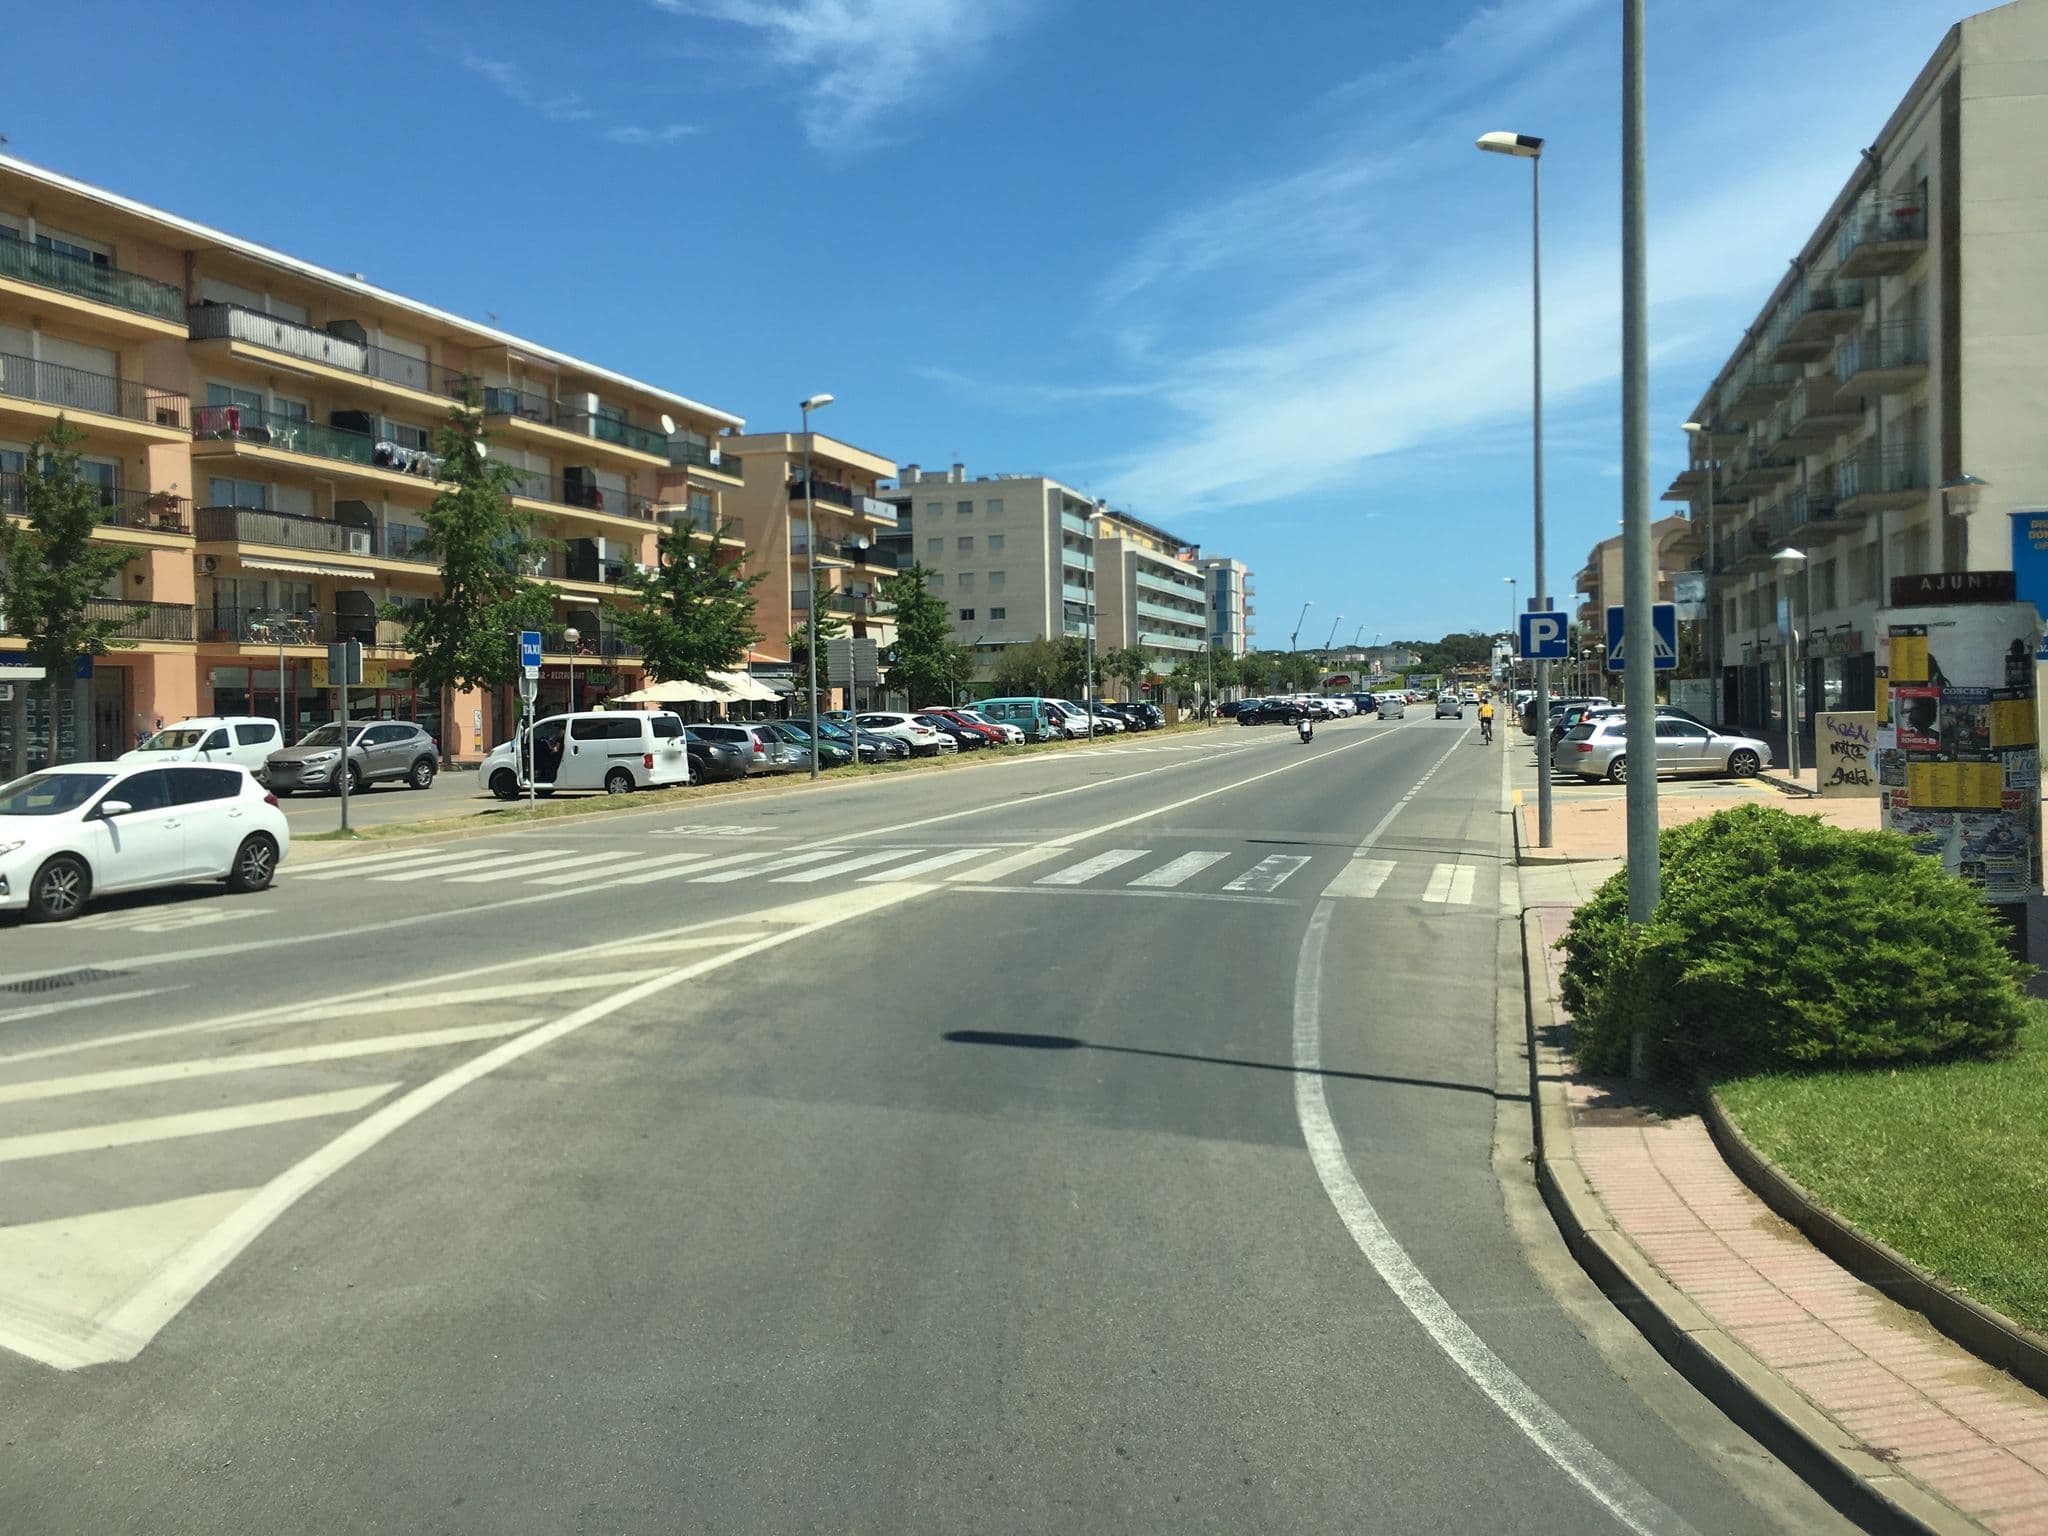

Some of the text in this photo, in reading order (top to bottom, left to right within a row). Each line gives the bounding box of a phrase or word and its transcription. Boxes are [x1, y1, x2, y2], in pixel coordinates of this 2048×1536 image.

[1530, 618, 1559, 654] P
[523, 644, 540, 655] TAXI
[551, 671, 585, 680] RESTAUANT
[1942, 688, 1990, 696] CONCERT
